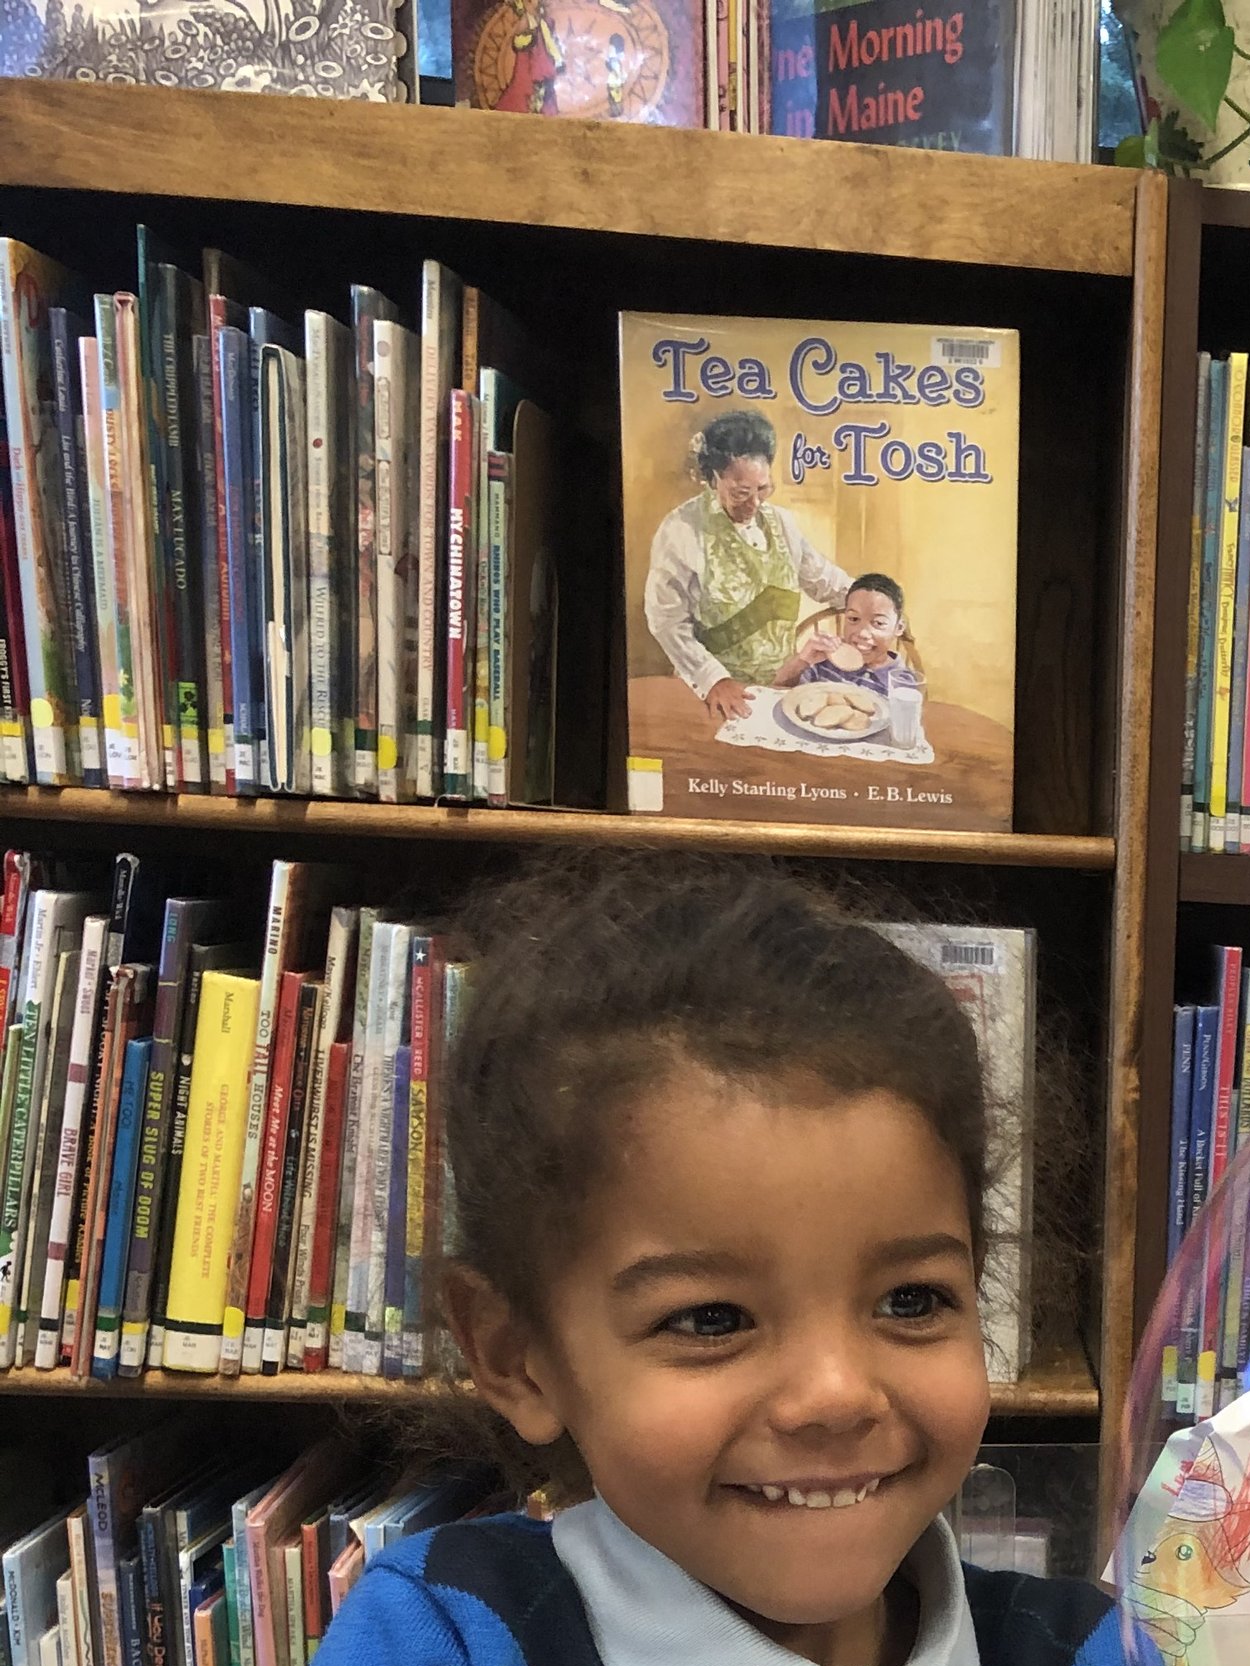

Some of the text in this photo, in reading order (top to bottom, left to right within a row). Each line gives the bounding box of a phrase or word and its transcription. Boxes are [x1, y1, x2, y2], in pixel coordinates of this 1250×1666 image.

[829, 10, 965, 73] Morning
[827, 82, 925, 137] Maine
[652, 336, 985, 415] Tea Cakes
[791, 421, 993, 486] for Tosh
[171, 490, 186, 590] MAX LUCADO
[493, 544, 501, 585] RHINOS
[449, 508, 463, 638] MY CHINATOWN
[492, 618, 500, 645] PLAY
[492, 649, 500, 702] BASEBALL
[167, 912, 178, 942] LONG
[269, 906, 282, 955] MARINO
[221, 991, 234, 1033] Marshall
[248, 1010, 270, 1139] TOO TALL HOUSES
[1181, 1044, 1191, 1074] PENN
[3, 1010, 37, 1228] TEN LITTLE CATERPILLARS
[262, 1084, 284, 1212] Meet Me at the MOON
[302, 1050, 325, 1198] LIVERWURST IS MISSING
[1178, 1140, 1188, 1158] The
[56, 1128, 78, 1198] BRAVE GIRL
[135, 1072, 164, 1238] SUPER SLUG OF DOOM
[190, 1102, 215, 1258] STORIES OF TWO BEST FRIENDS
[1176, 1162, 1188, 1196] Kissing
